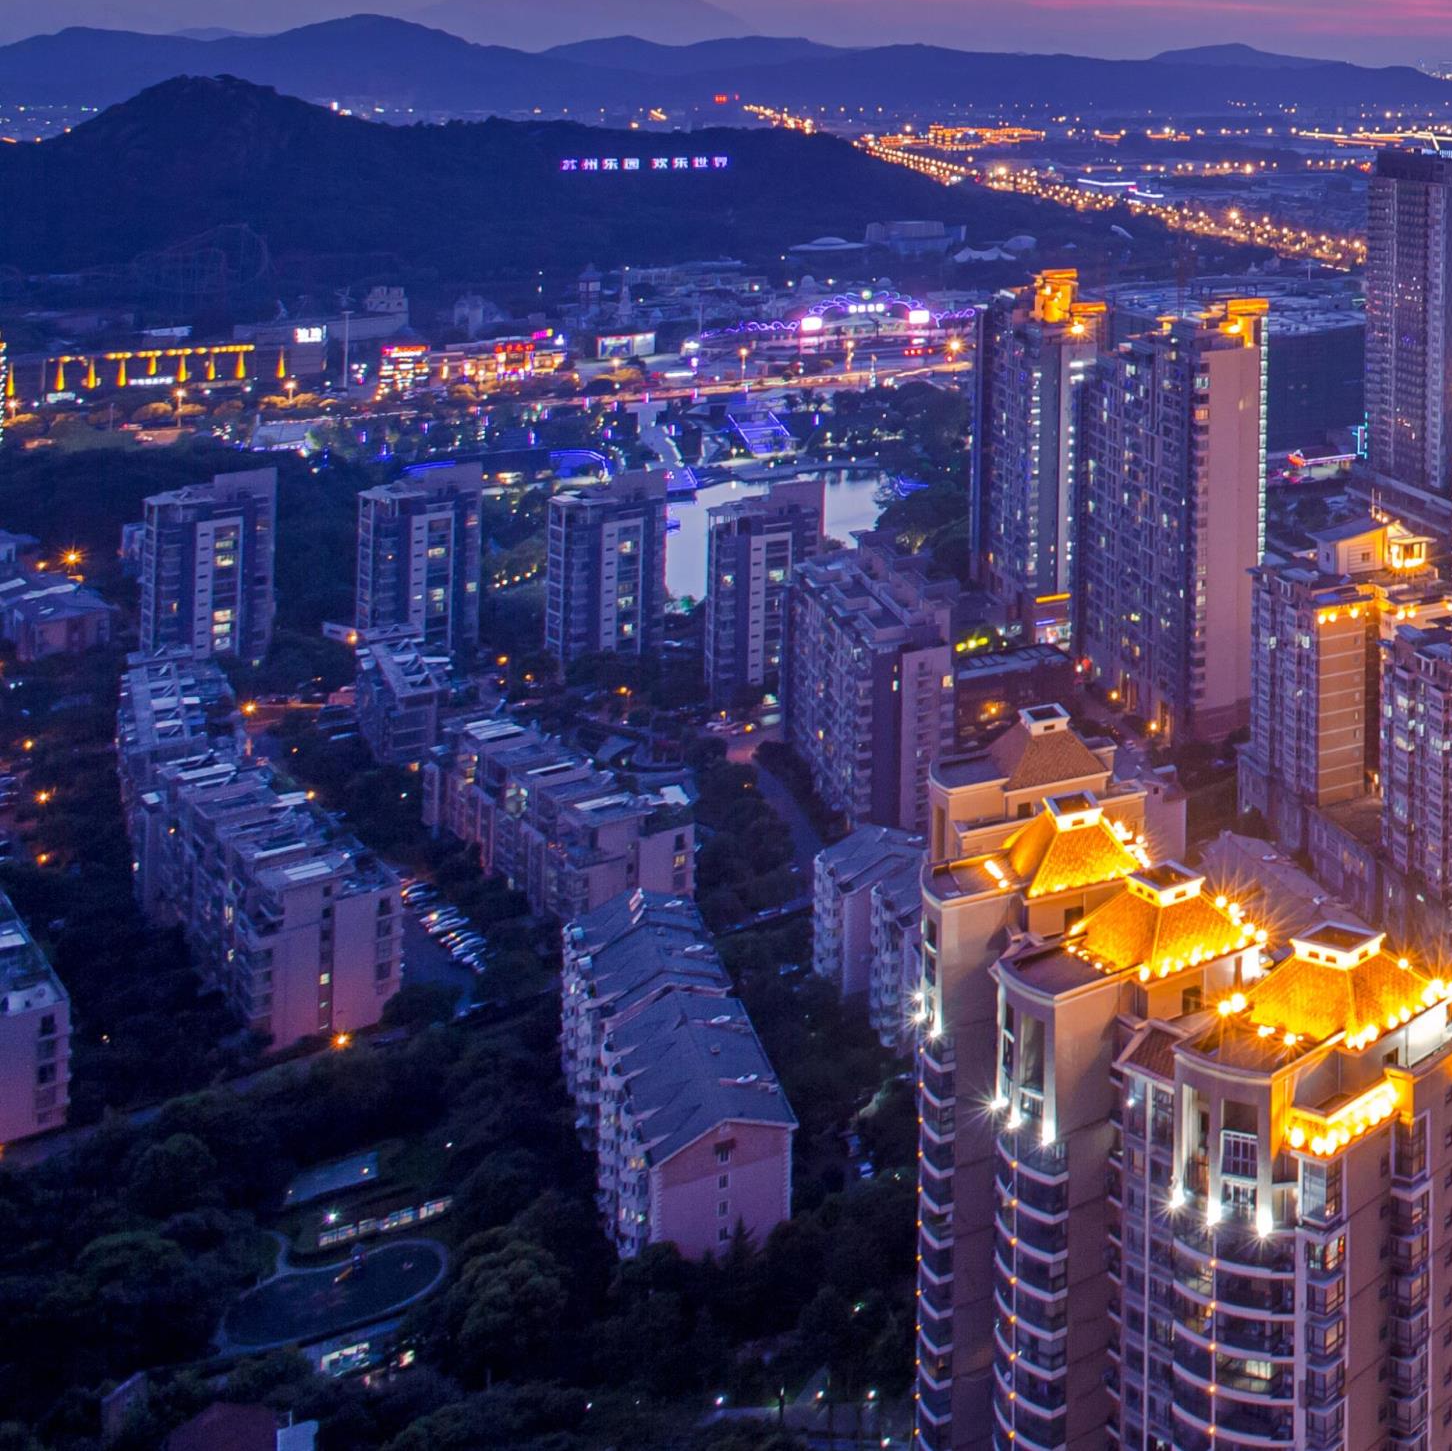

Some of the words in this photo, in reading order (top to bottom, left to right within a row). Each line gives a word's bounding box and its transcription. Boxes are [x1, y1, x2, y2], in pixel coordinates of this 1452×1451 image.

[561, 157, 640, 171] 苏州乐园
[651, 156, 728, 170] 欢乐世界
